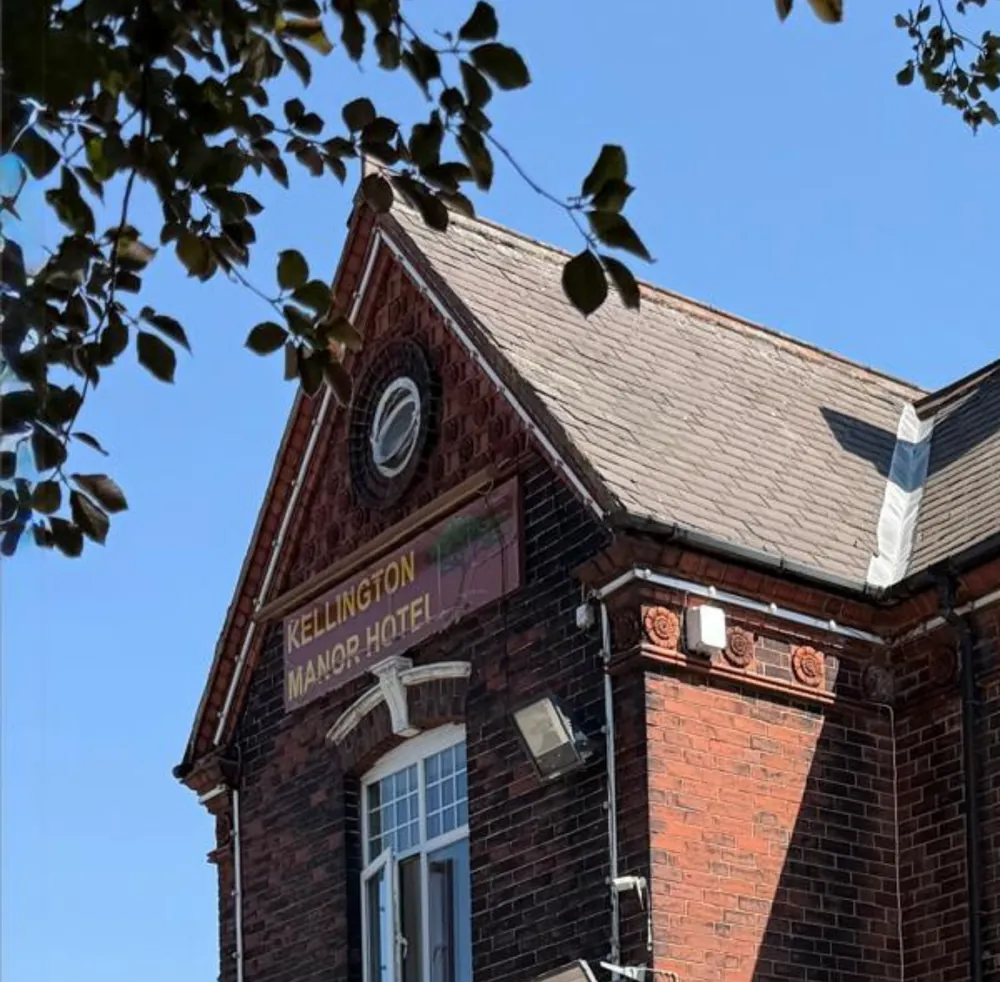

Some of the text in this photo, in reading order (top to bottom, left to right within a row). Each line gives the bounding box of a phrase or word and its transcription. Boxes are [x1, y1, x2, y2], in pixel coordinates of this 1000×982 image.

[287, 551, 415, 653] KELLINGTON
[288, 593, 432, 700] MANOR HOTEL
